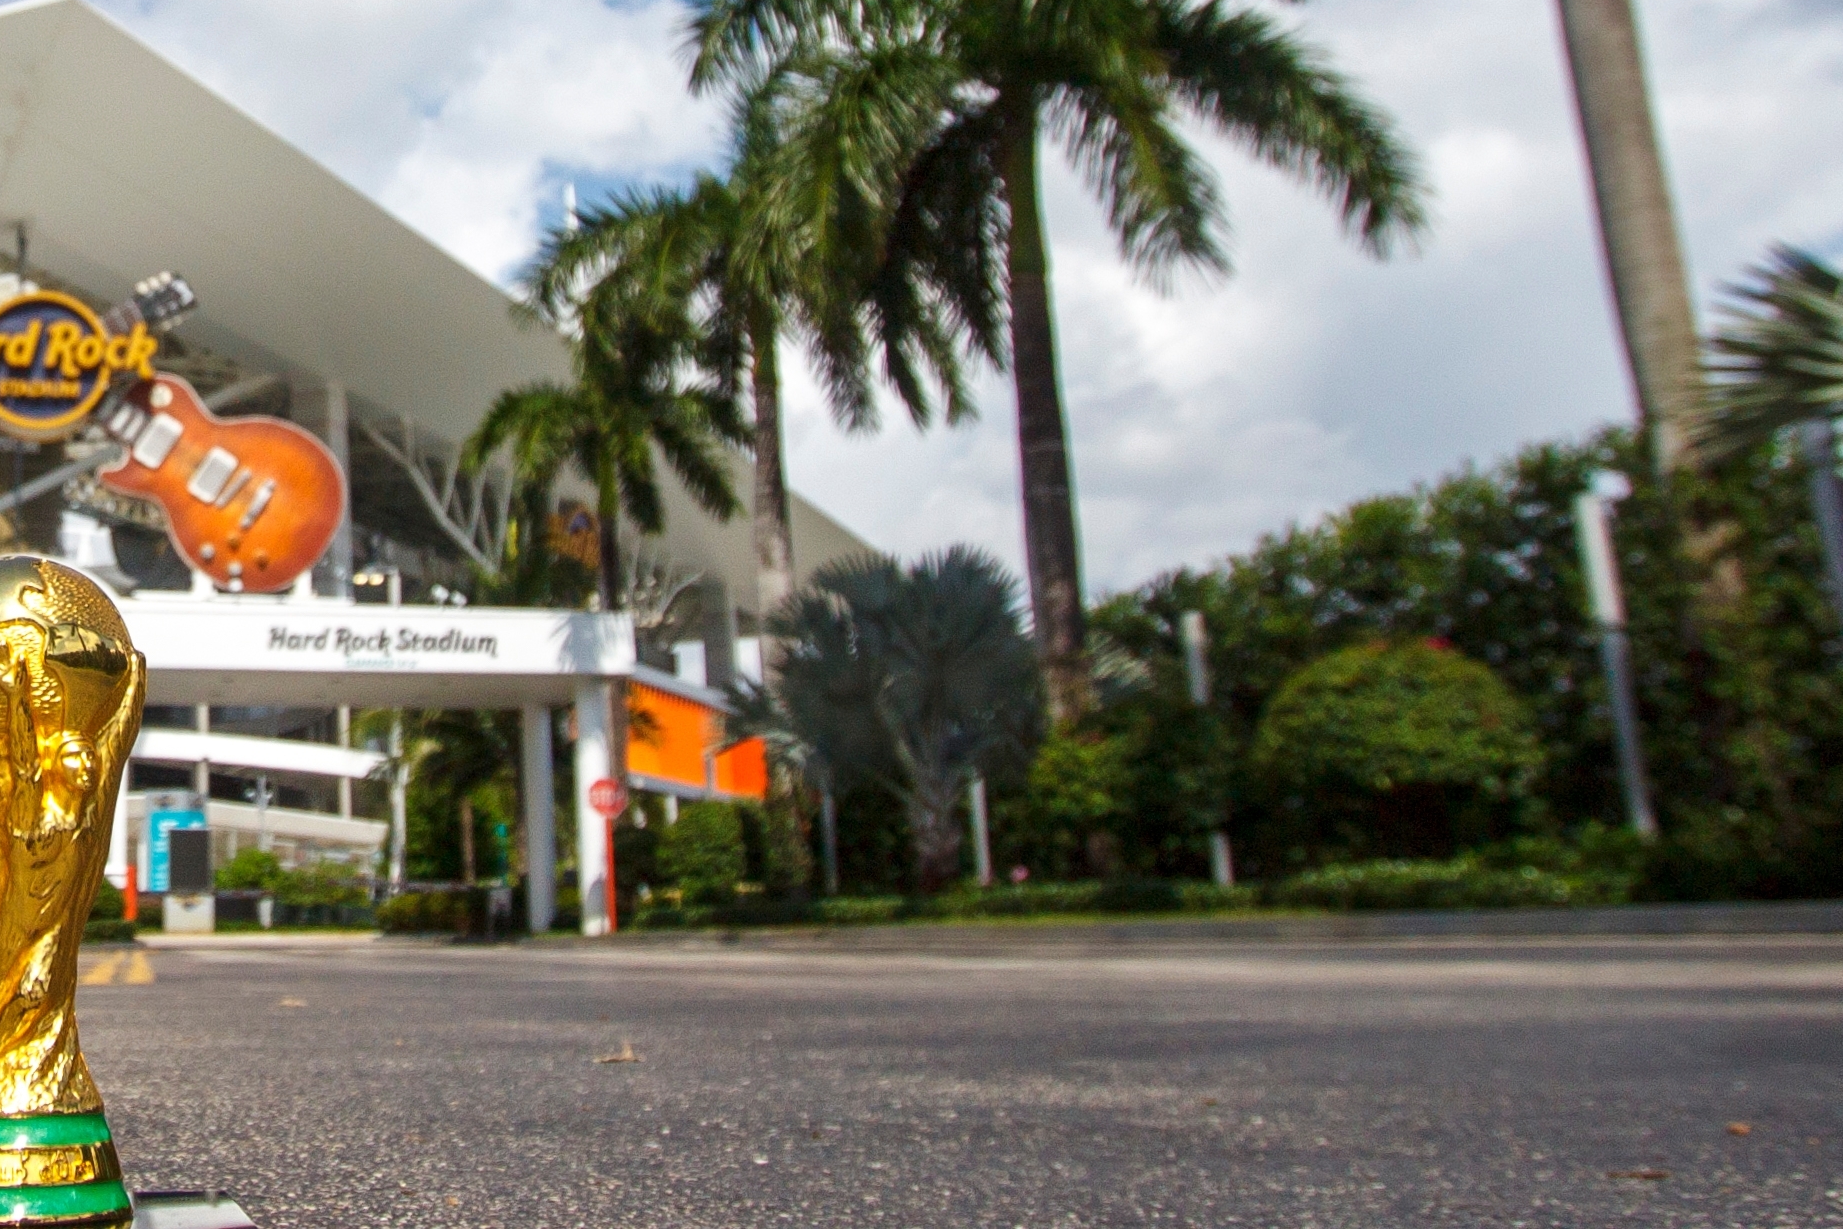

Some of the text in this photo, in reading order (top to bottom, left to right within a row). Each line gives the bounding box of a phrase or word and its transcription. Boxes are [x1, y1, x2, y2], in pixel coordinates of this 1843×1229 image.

[43, 322, 158, 380] Rock
[269, 626, 499, 658] Hard Rock Stadium
